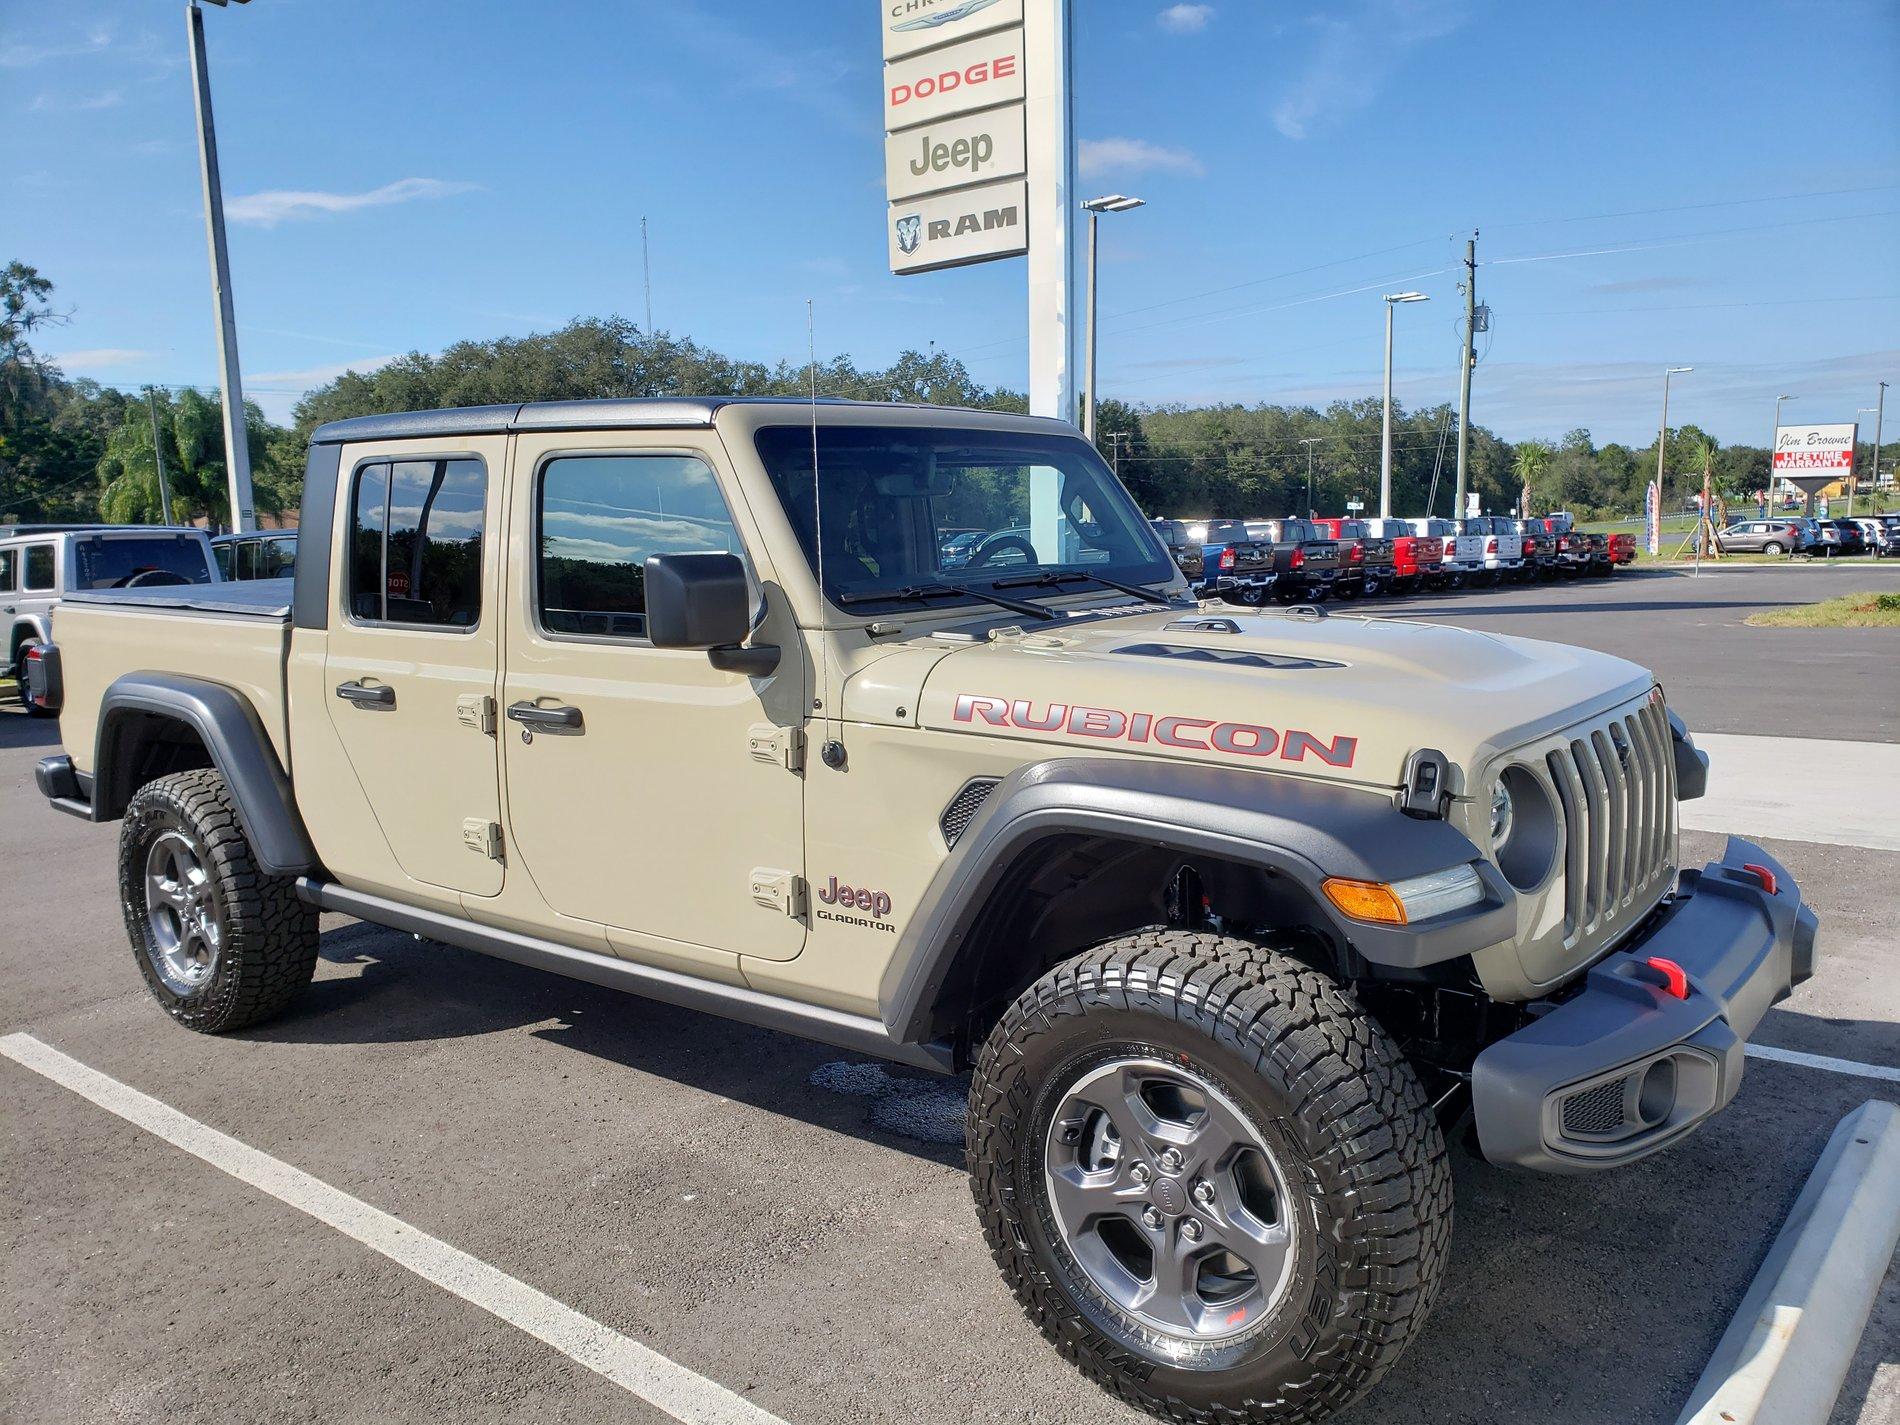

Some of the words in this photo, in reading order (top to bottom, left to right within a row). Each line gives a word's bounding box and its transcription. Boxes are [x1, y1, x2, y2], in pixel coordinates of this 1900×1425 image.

[892, 0, 942, 17] CHR
[891, 55, 1016, 106] DODGE
[910, 133, 993, 176] Jeep
[928, 206, 1017, 241] RAM
[1778, 433, 1801, 451] Jim
[1807, 432, 1850, 445] Browne
[1783, 451, 1843, 461] LIFETIME
[1776, 459, 1850, 468] WARRANTY
[953, 693, 1358, 768] RUBICON
[818, 875, 892, 919] Jeep
[817, 910, 896, 933] GLADIATOR
